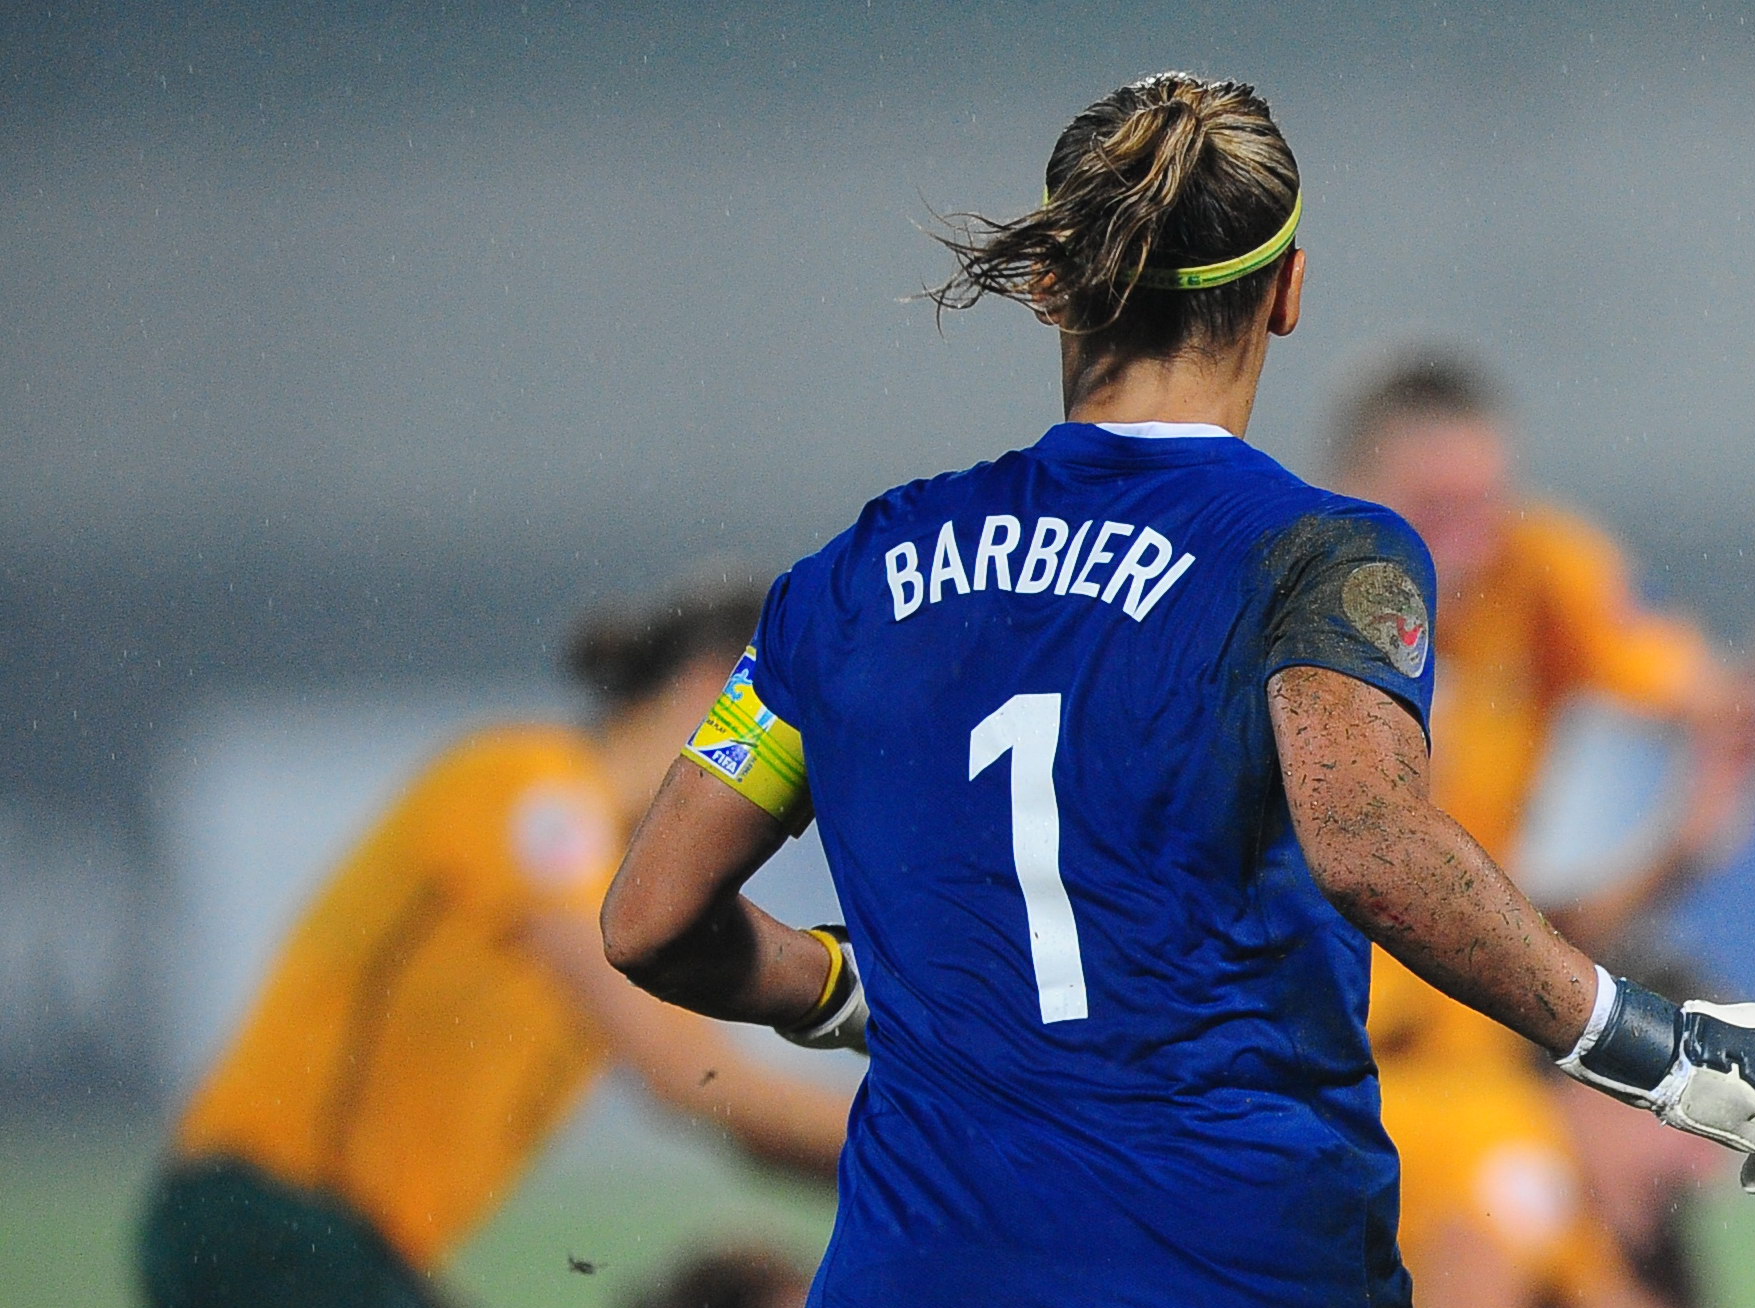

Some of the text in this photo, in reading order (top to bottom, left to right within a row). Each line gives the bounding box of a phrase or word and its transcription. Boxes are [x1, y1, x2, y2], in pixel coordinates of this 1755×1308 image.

[885, 514, 1196, 622] BARBIERI
[711, 749, 738, 773] FIFA
[969, 693, 1088, 1024] 1
